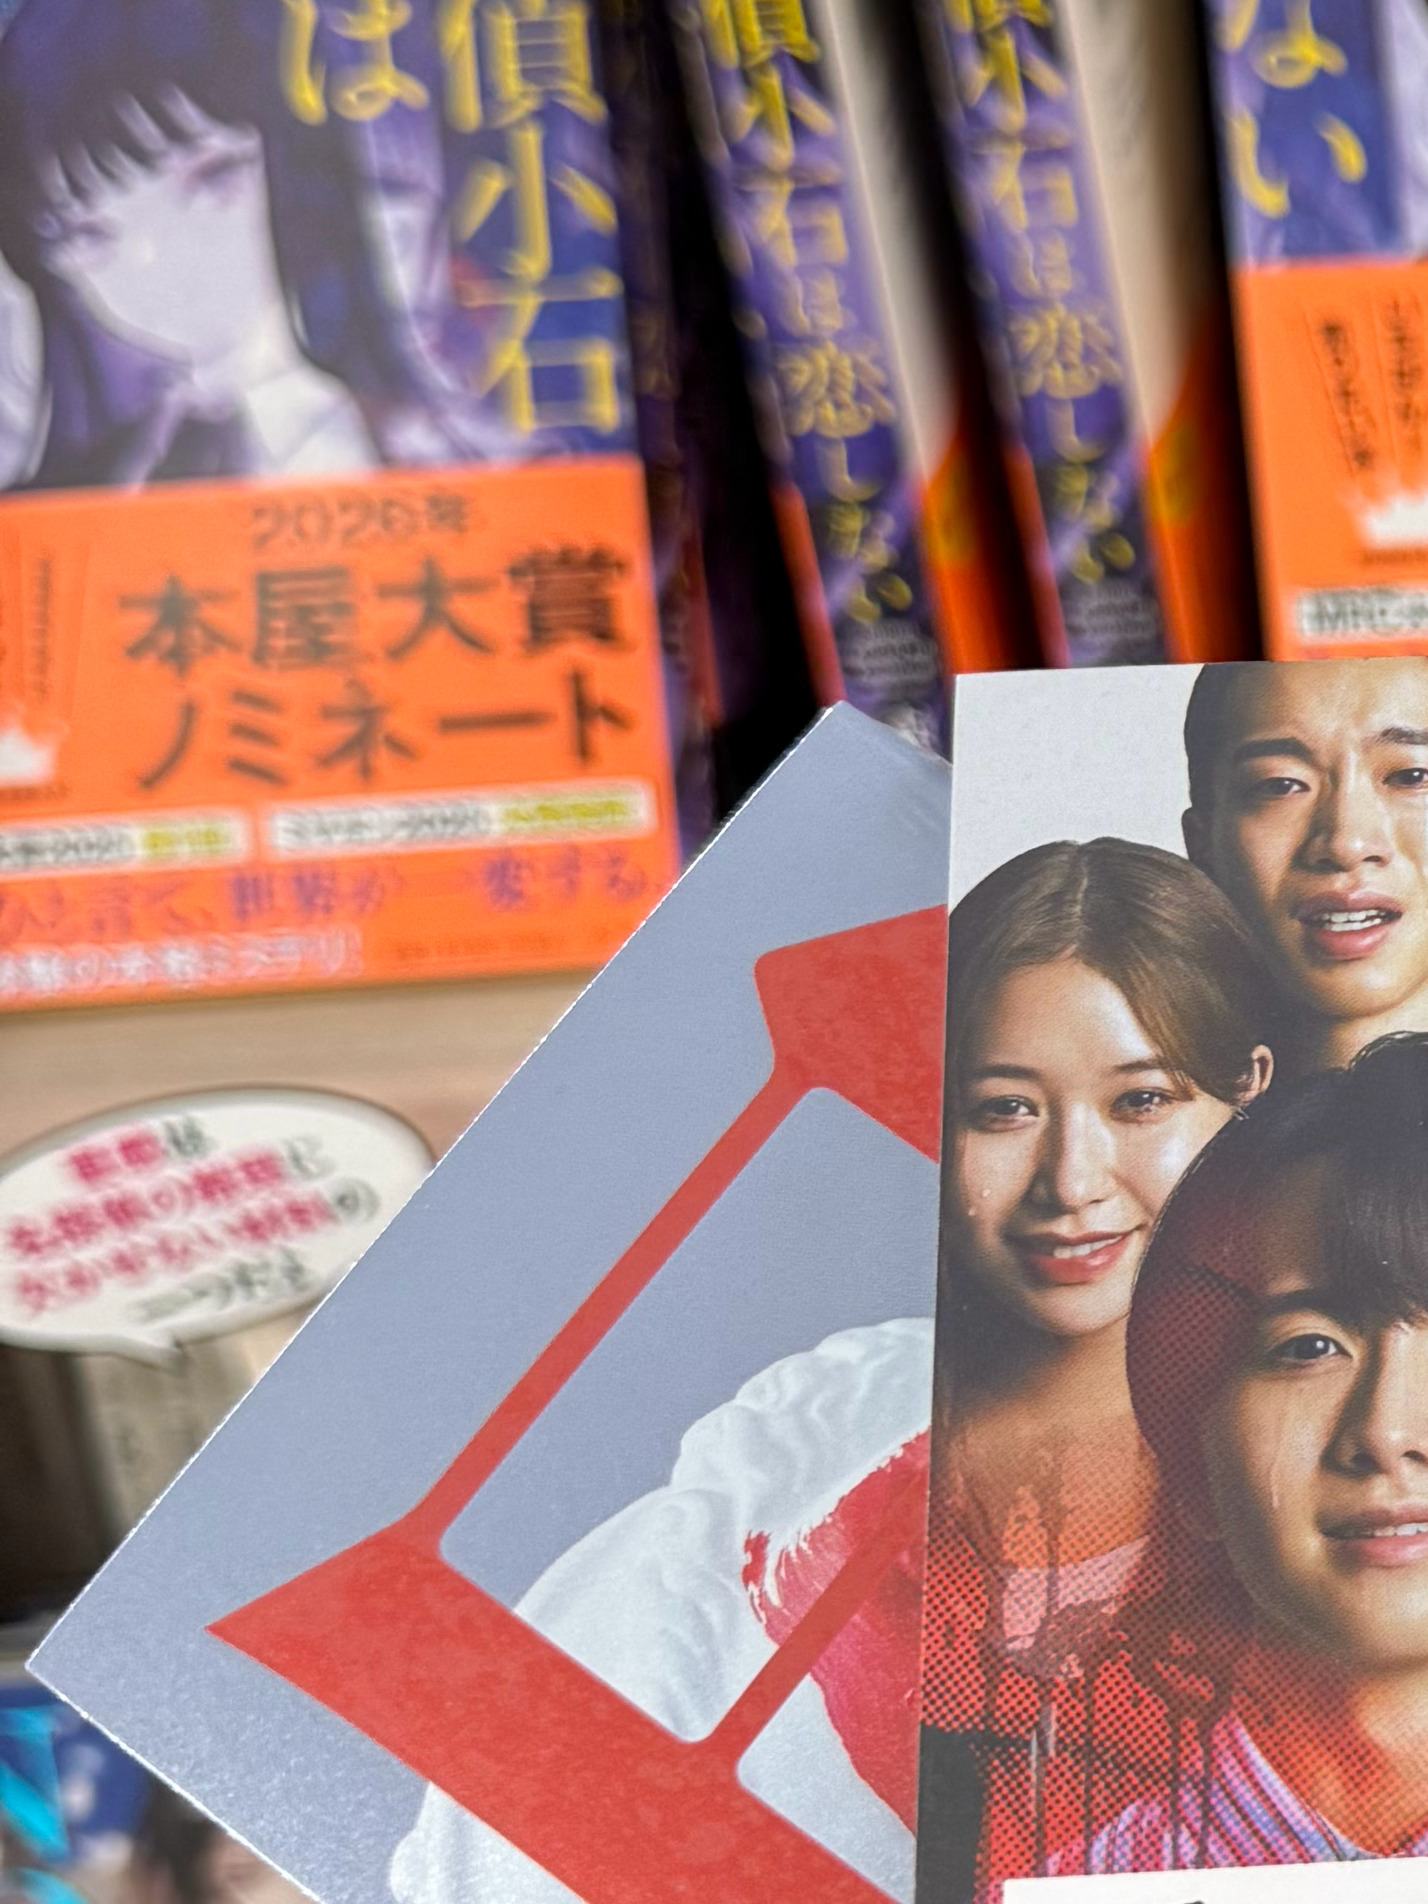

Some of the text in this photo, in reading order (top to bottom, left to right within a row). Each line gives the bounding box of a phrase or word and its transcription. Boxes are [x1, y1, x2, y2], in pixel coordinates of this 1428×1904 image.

[114, 542, 636, 678] 本屋大賞
[138, 670, 634, 792] ノミネート
